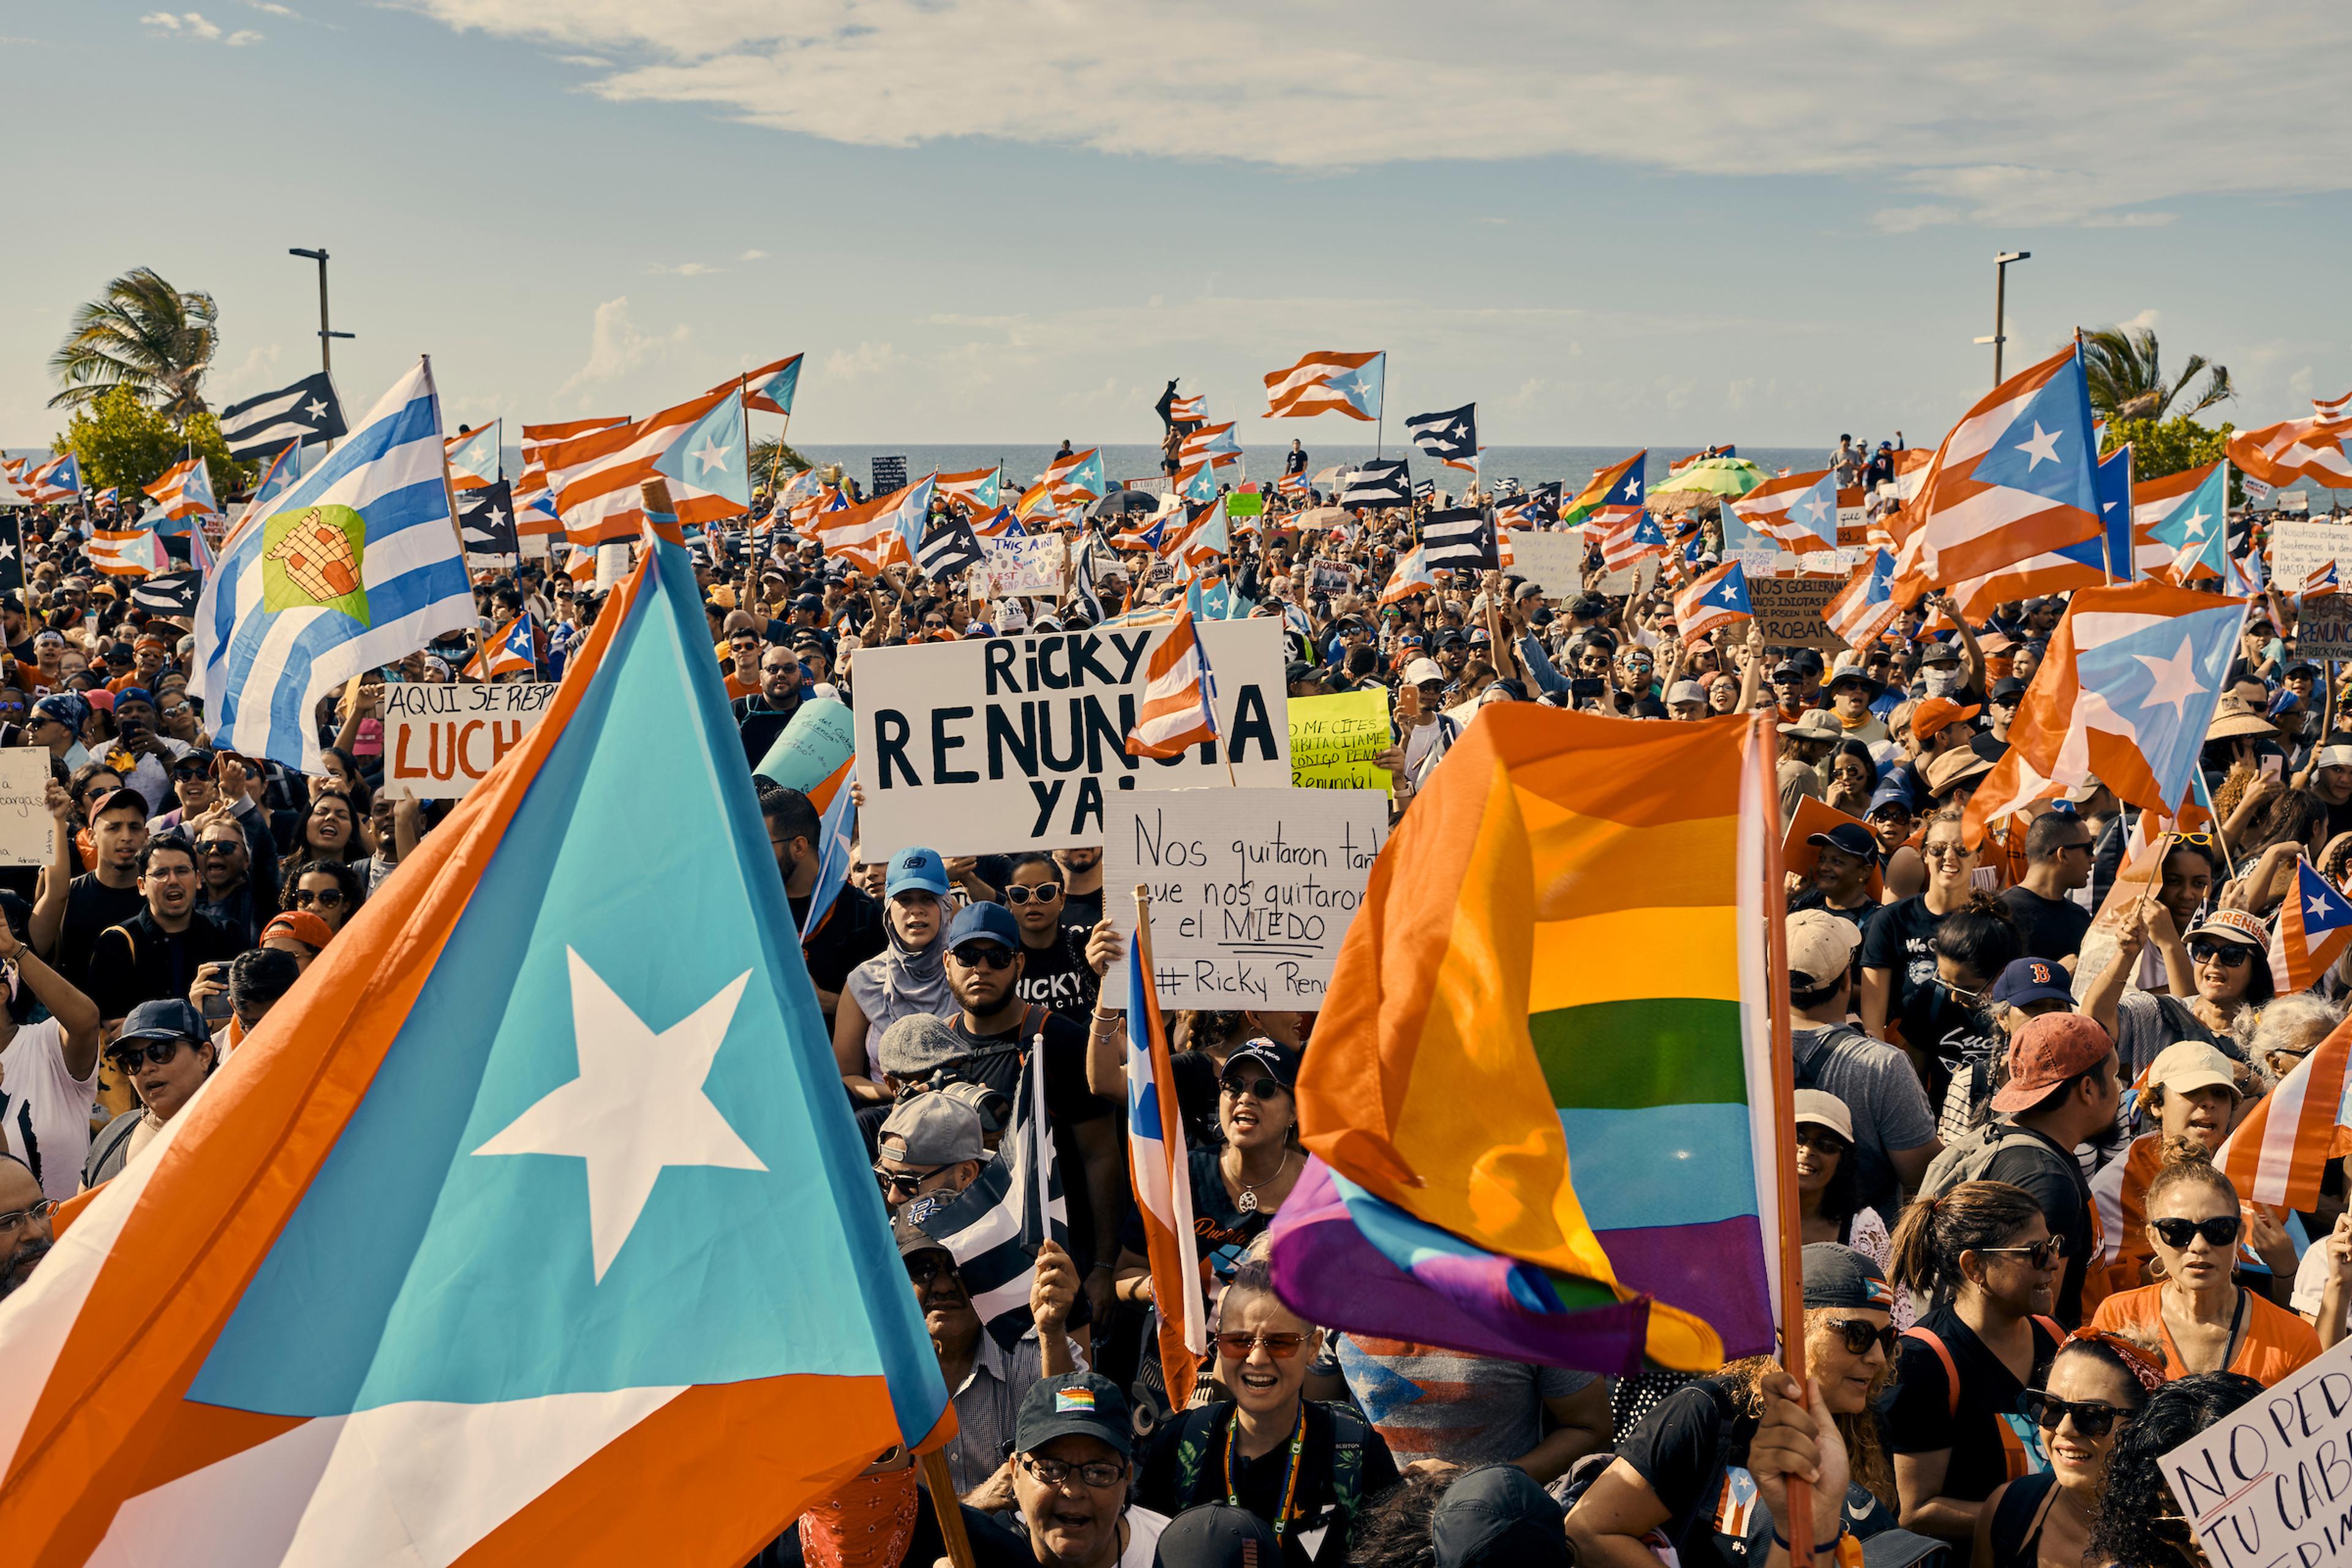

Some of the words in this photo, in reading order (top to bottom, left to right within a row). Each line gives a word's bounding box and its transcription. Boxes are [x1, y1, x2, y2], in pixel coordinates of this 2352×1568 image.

[2281, 527, 2318, 537] Nosotros
[2320, 529, 2350, 540] estamos
[992, 538, 1023, 554] THIS
[2280, 540, 2323, 551] Sostenemos
[1749, 579, 1782, 595] NOS
[1777, 597, 1821, 607] IDIOTAS
[1771, 609, 1800, 618] POSEEN
[985, 631, 1152, 695] RICKY
[386, 685, 461, 718] AQUI
[469, 686, 502, 711] SE
[1304, 720, 1329, 734] ME
[1331, 718, 1378, 734] CITES
[875, 684, 1278, 790] RENUNA
[1135, 808, 1207, 866] Nos
[1232, 820, 1327, 889] quitaron
[1204, 880, 1254, 906] nos
[1180, 910, 1202, 938] el
[1224, 908, 1325, 942] MIEDO
[1906, 938, 1926, 952] We
[2030, 963, 2051, 984] B
[2176, 1424, 2268, 1518] NO
[2200, 1506, 2260, 1568] TU
